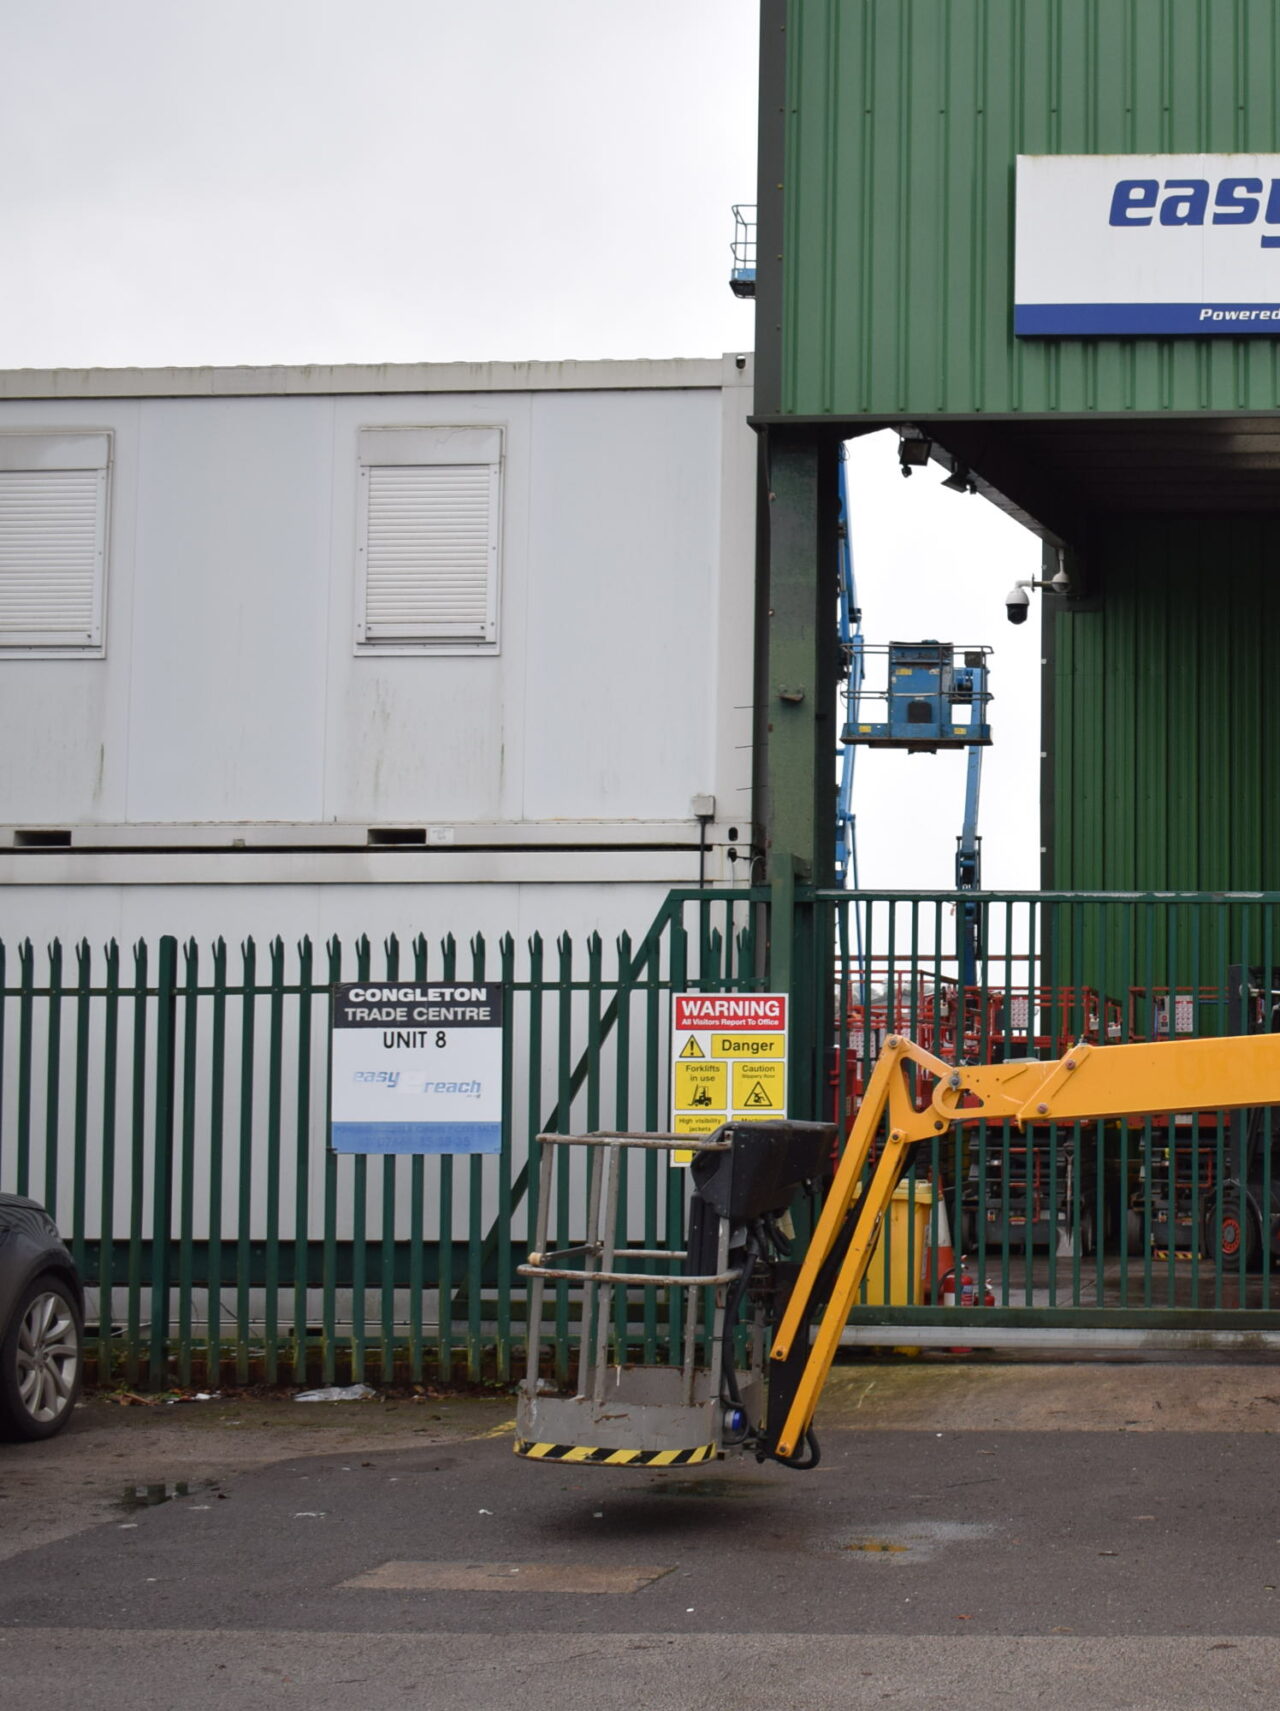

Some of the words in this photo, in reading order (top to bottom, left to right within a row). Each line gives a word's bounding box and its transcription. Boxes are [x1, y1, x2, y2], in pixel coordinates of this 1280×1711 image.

[349, 988, 487, 1002] CONGLETON
[344, 1007, 408, 1021] TRADE
[413, 1007, 491, 1021] CENTRE
[681, 1000, 780, 1017] WARNING
[682, 1018, 692, 1026] All
[693, 1018, 720, 1026] Visitors
[721, 1018, 746, 1027] Report
[747, 1018, 757, 1026] To
[757, 1018, 779, 1026] Office
[383, 1031, 428, 1049] UNIT
[435, 1030, 447, 1049] 8
[721, 1039, 775, 1054] Danger
[685, 1064, 721, 1073] Forklifts
[741, 1064, 775, 1073] Caution
[353, 1071, 400, 1088] easy
[423, 1080, 481, 1094] reach
